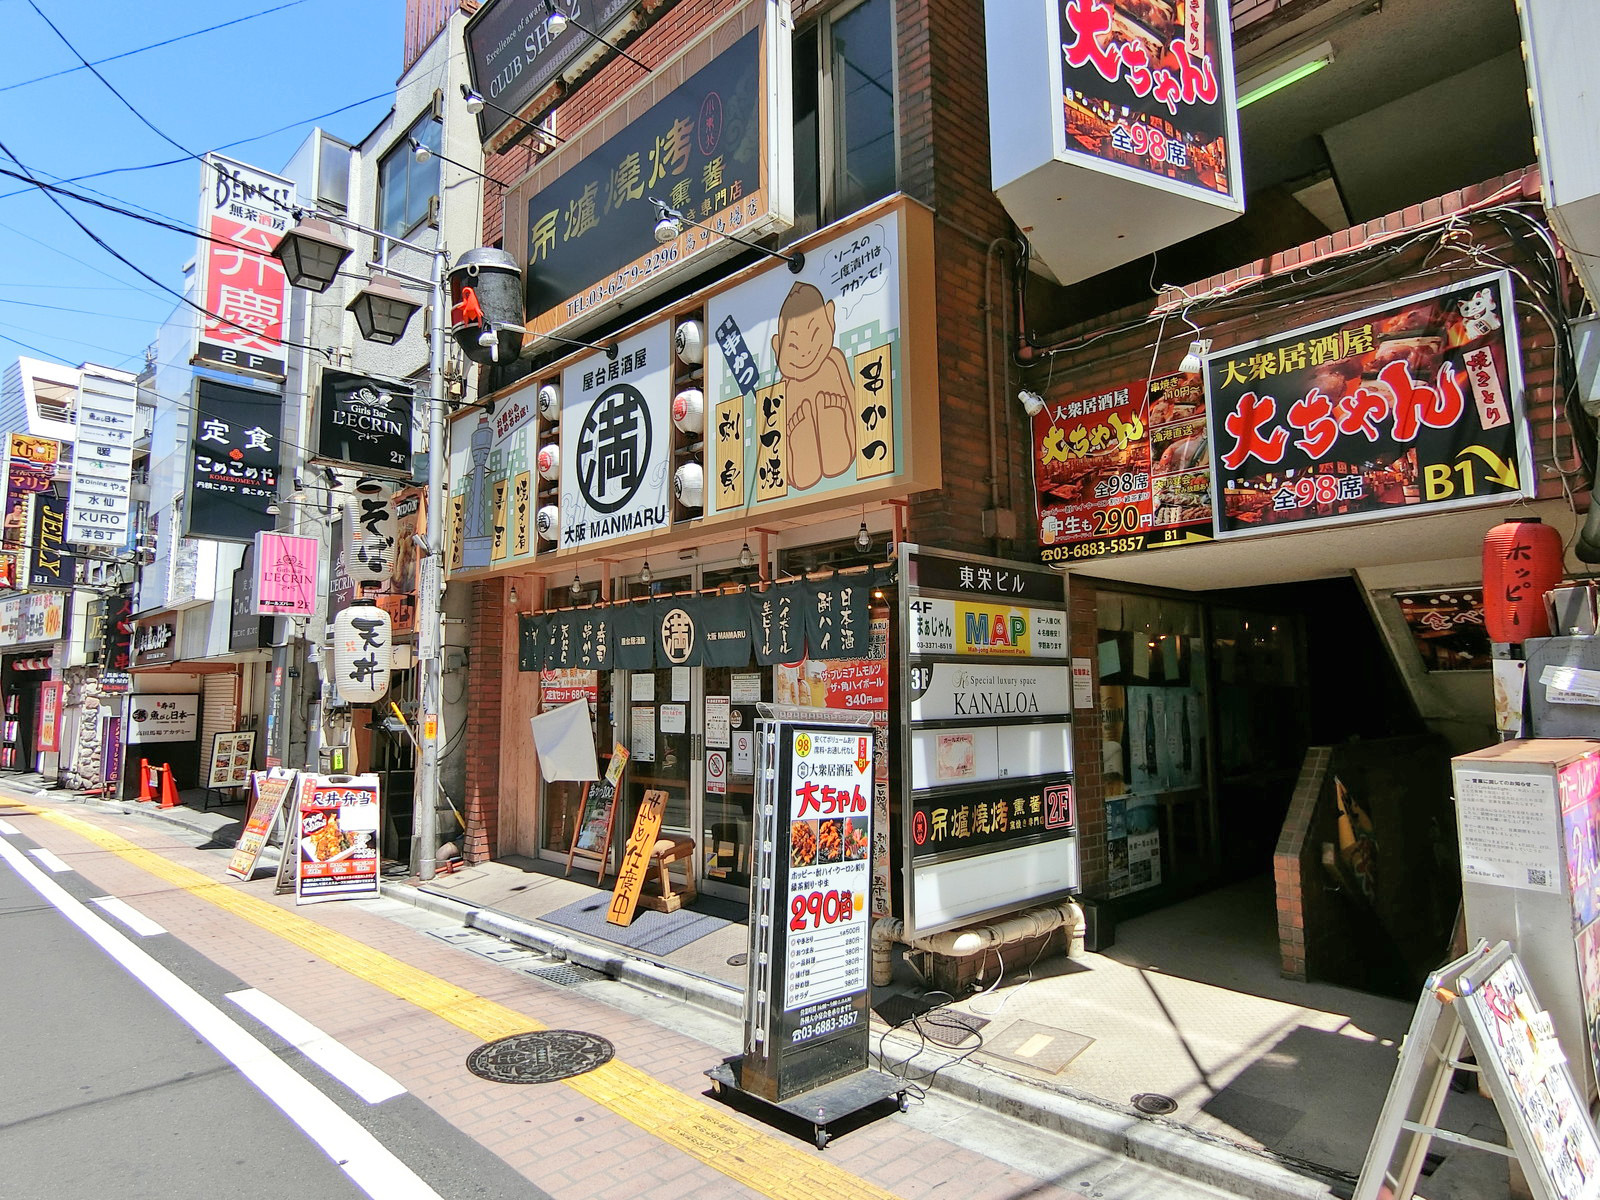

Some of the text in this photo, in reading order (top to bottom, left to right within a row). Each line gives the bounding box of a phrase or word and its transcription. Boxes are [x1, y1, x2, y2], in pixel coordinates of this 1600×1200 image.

[486, 29, 517, 66] Excellence
[1063, 0, 1218, 116] 大ちゃん
[490, 56, 523, 99] CLUB
[1110, 122, 1187, 167] 全98席
[830, 245, 882, 285] 二度漬けは
[834, 235, 871, 262] ソースの
[205, 226, 286, 353] 弁慶
[566, 243, 679, 319] TEL:03-6279-2296
[221, 349, 264, 369] 2F
[582, 347, 647, 393] 屋台居酒屋
[1220, 323, 1375, 390] 大衆居酒屋
[1150, 377, 1179, 393] 串焼き
[351, 404, 387, 419] Girls Bar
[861, 355, 887, 461] 串かつ
[1053, 388, 1130, 422] 大衆居酒屋
[1221, 360, 1464, 470] 大ちゃん
[201, 418, 273, 453] 定食
[578, 388, 648, 508] 満
[1041, 410, 1144, 465] 大ちゃん
[1153, 424, 1194, 442] 漁港直送
[197, 455, 274, 482] こめこめや
[390, 450, 406, 464] 2F
[209, 474, 261, 486] KOMEKOMEYA
[1094, 472, 1149, 498] 全98席
[1272, 475, 1363, 512] 全98席
[1424, 459, 1475, 501] B1
[79, 511, 120, 525] KURO
[88, 496, 115, 507] 水仙
[39, 505, 63, 577] JELLY
[81, 528, 116, 541] 洋包丁
[564, 505, 666, 545] 大阪 MANMARU
[1164, 529, 1178, 541] B1
[1053, 535, 1144, 561] 03-6883-5857
[34, 574, 49, 584] B1
[959, 565, 1025, 593] 東栄ビル
[1505, 542, 1532, 625] ホッピー
[817, 591, 833, 651] 酎ハイ
[840, 587, 855, 650] 日本酒
[910, 600, 933, 613] 4F
[663, 610, 693, 660] 満
[717, 630, 747, 640] MANMARU
[760, 600, 773, 656] 生ビール
[779, 597, 793, 654] ハイボール
[965, 612, 1027, 647] MAP
[821, 664, 882, 682] ザ・プレミアムモルツ
[830, 677, 885, 693] ザ・角ハイボール
[911, 667, 929, 690] 3F
[970, 675, 1037, 688] Special luxury space
[953, 691, 1040, 716] KANALOA
[809, 763, 854, 778] 大衆居酒屋
[858, 758, 866, 768] B1
[795, 781, 867, 818] 大ちゃん
[1048, 790, 1069, 823] 2F
[801, 1010, 858, 1039] 03-6883-5857
